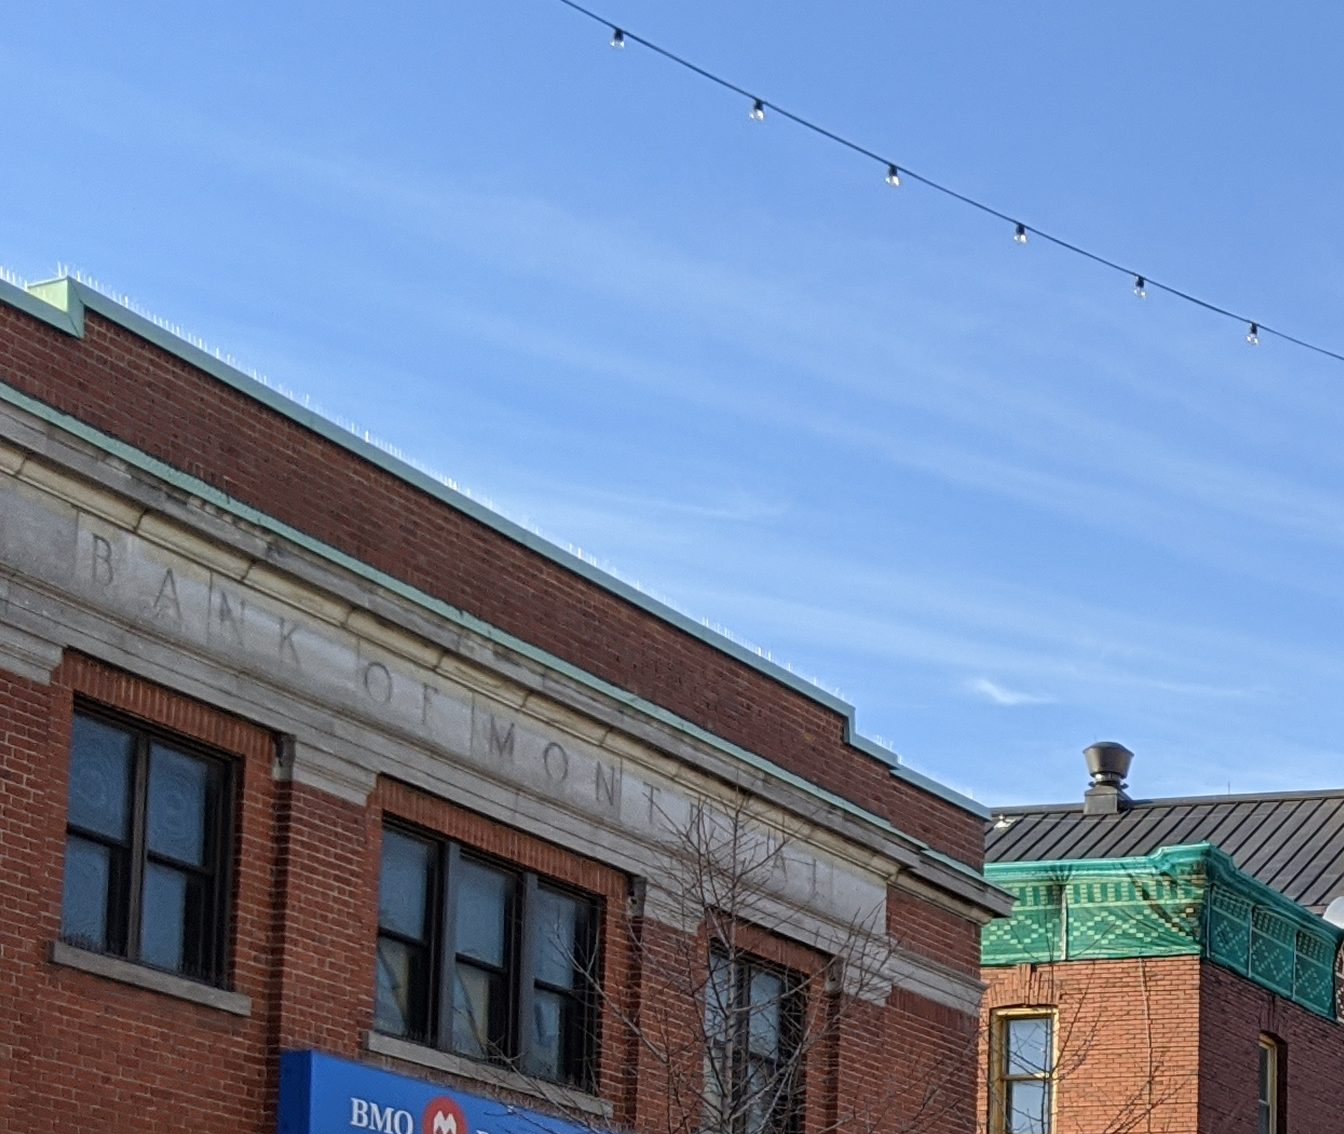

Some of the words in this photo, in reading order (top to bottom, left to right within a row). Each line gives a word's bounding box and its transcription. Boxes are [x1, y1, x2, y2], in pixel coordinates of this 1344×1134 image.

[89, 533, 299, 666] BANK
[364, 659, 440, 726] OF
[488, 713, 824, 900] MONTAL
